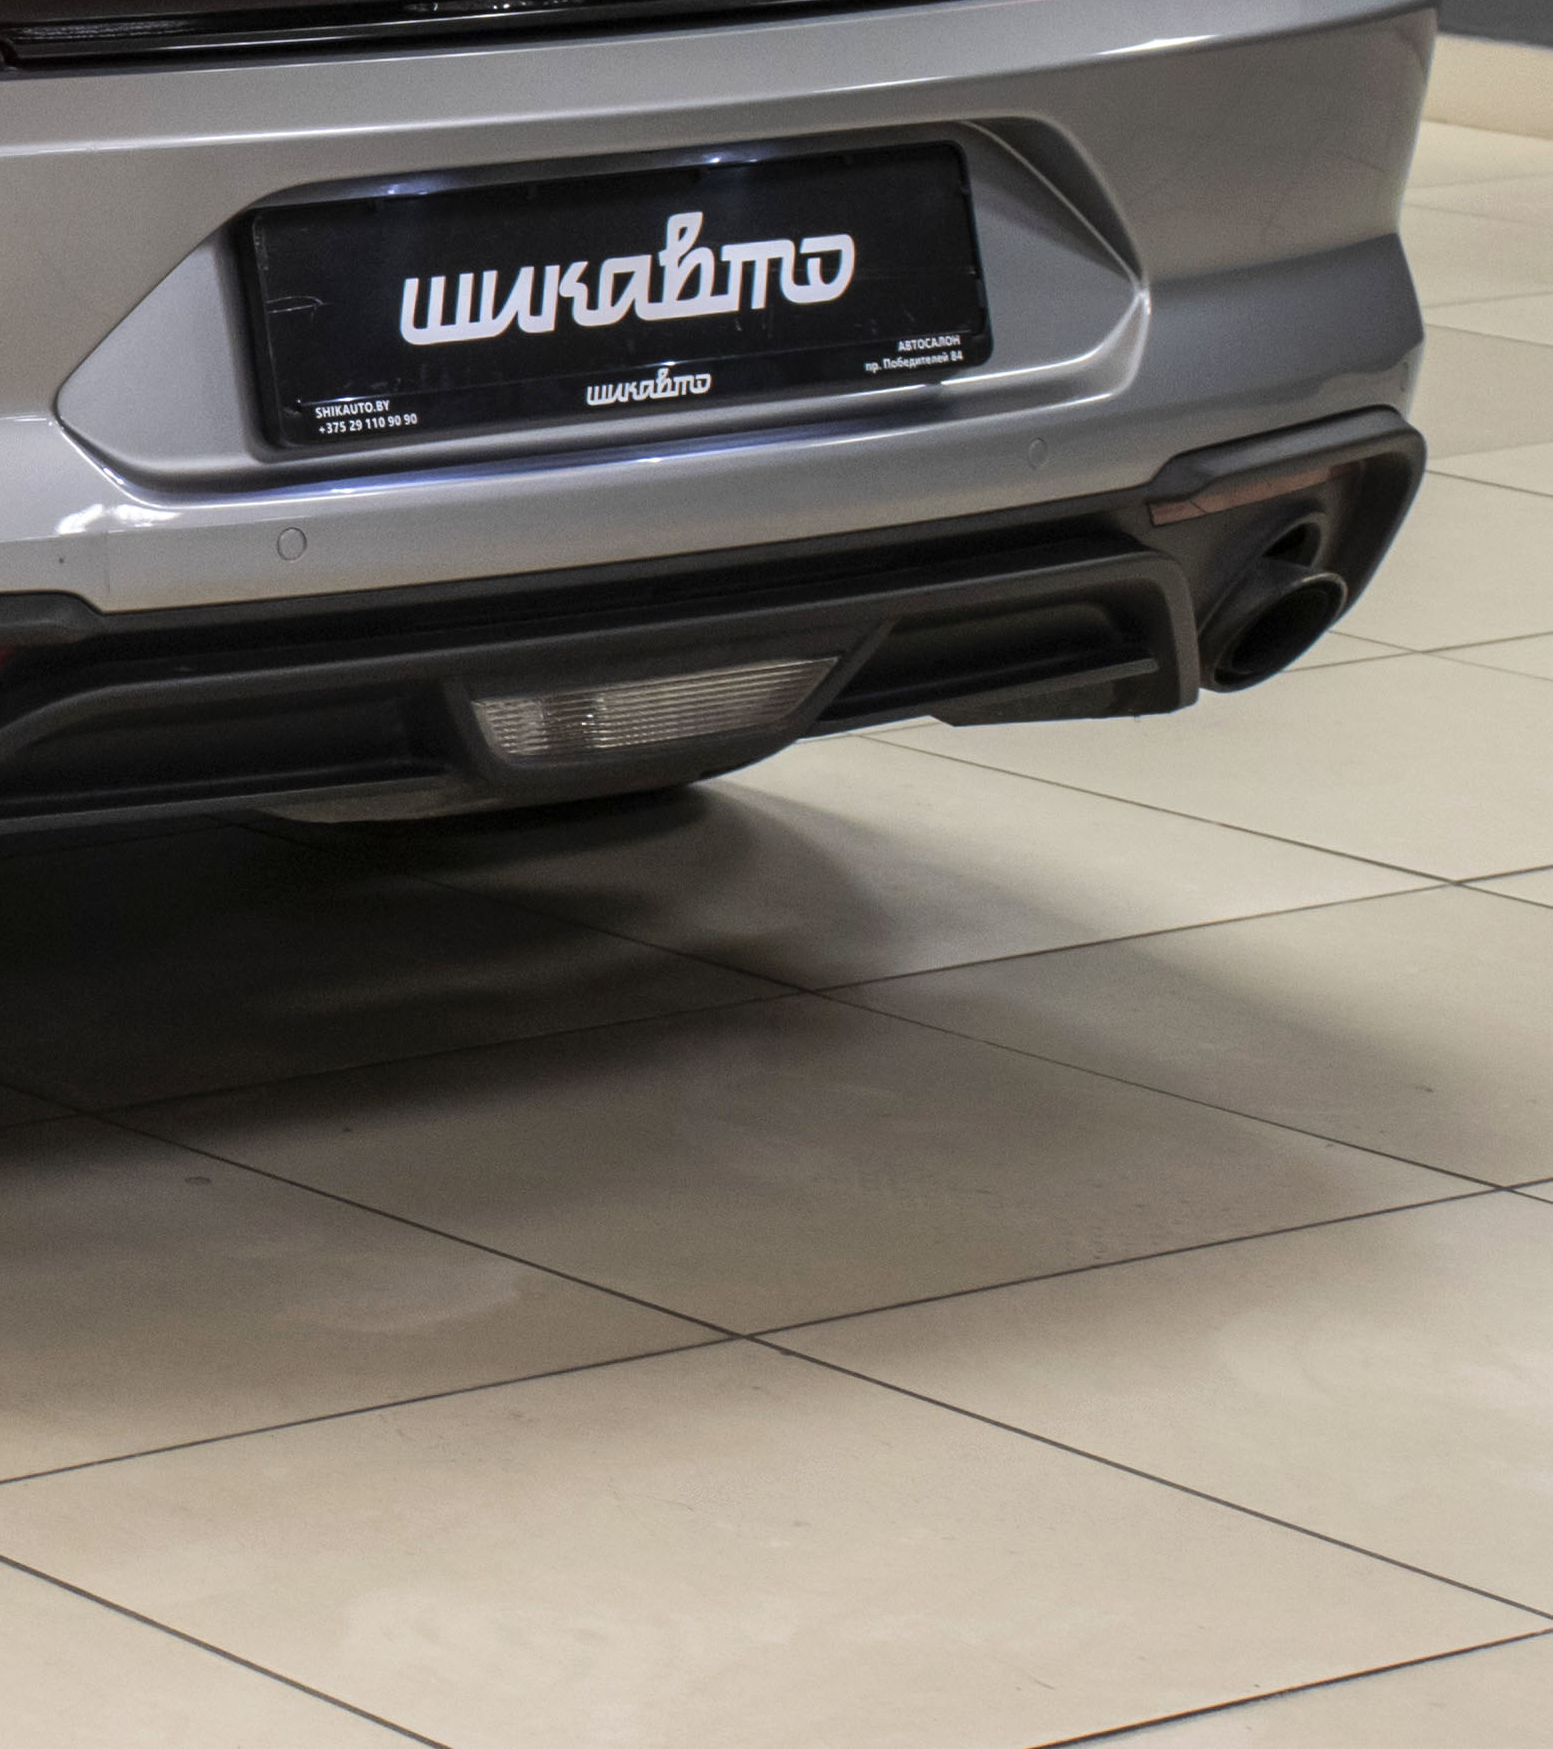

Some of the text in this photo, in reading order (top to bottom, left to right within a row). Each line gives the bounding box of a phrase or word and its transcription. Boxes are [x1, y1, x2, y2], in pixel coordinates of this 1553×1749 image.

[898, 335, 961, 351] АВТОСАЛОН
[865, 350, 963, 373] пр. Победителей 84
[314, 400, 390, 419] SHIKAUTO.BY
[319, 413, 418, 435] +375 29 110 90 90
